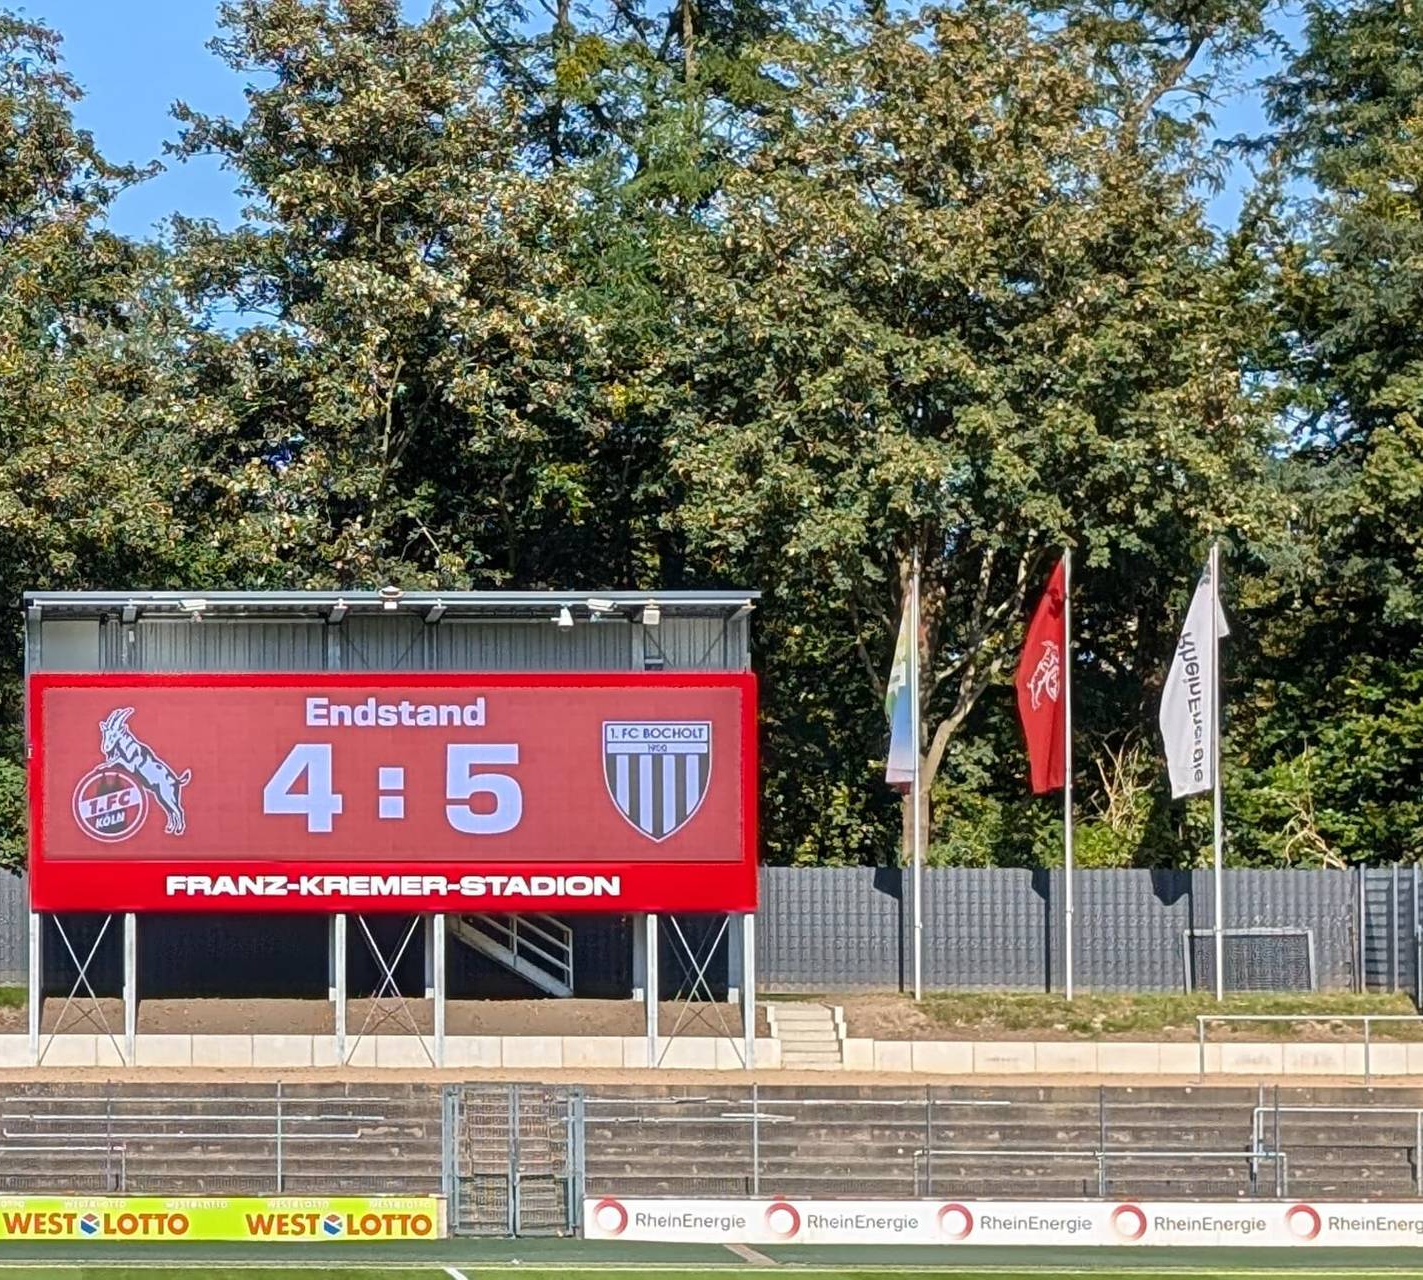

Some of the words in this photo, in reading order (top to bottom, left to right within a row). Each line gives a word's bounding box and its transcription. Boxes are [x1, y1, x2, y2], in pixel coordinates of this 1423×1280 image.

[306, 697, 486, 727] Endstand
[622, 728, 639, 740] FC
[643, 728, 704, 740] BOCHOLT
[263, 743, 343, 833] 4
[446, 743, 523, 835] 5
[95, 811, 125, 829] KÖLN
[166, 876, 620, 896] FRANZ-KREMER-STADION
[3, 1213, 77, 1235] WEST
[104, 1213, 189, 1235] LOTTO
[246, 1213, 320, 1236] WEST
[347, 1213, 432, 1236] LOTTO
[636, 1213, 746, 1231] RheinEnergie
[808, 1215, 919, 1232] RheinEnergie
[981, 1215, 1092, 1233] RheinEnergie
[1155, 1217, 1266, 1234] RheinEnergie
